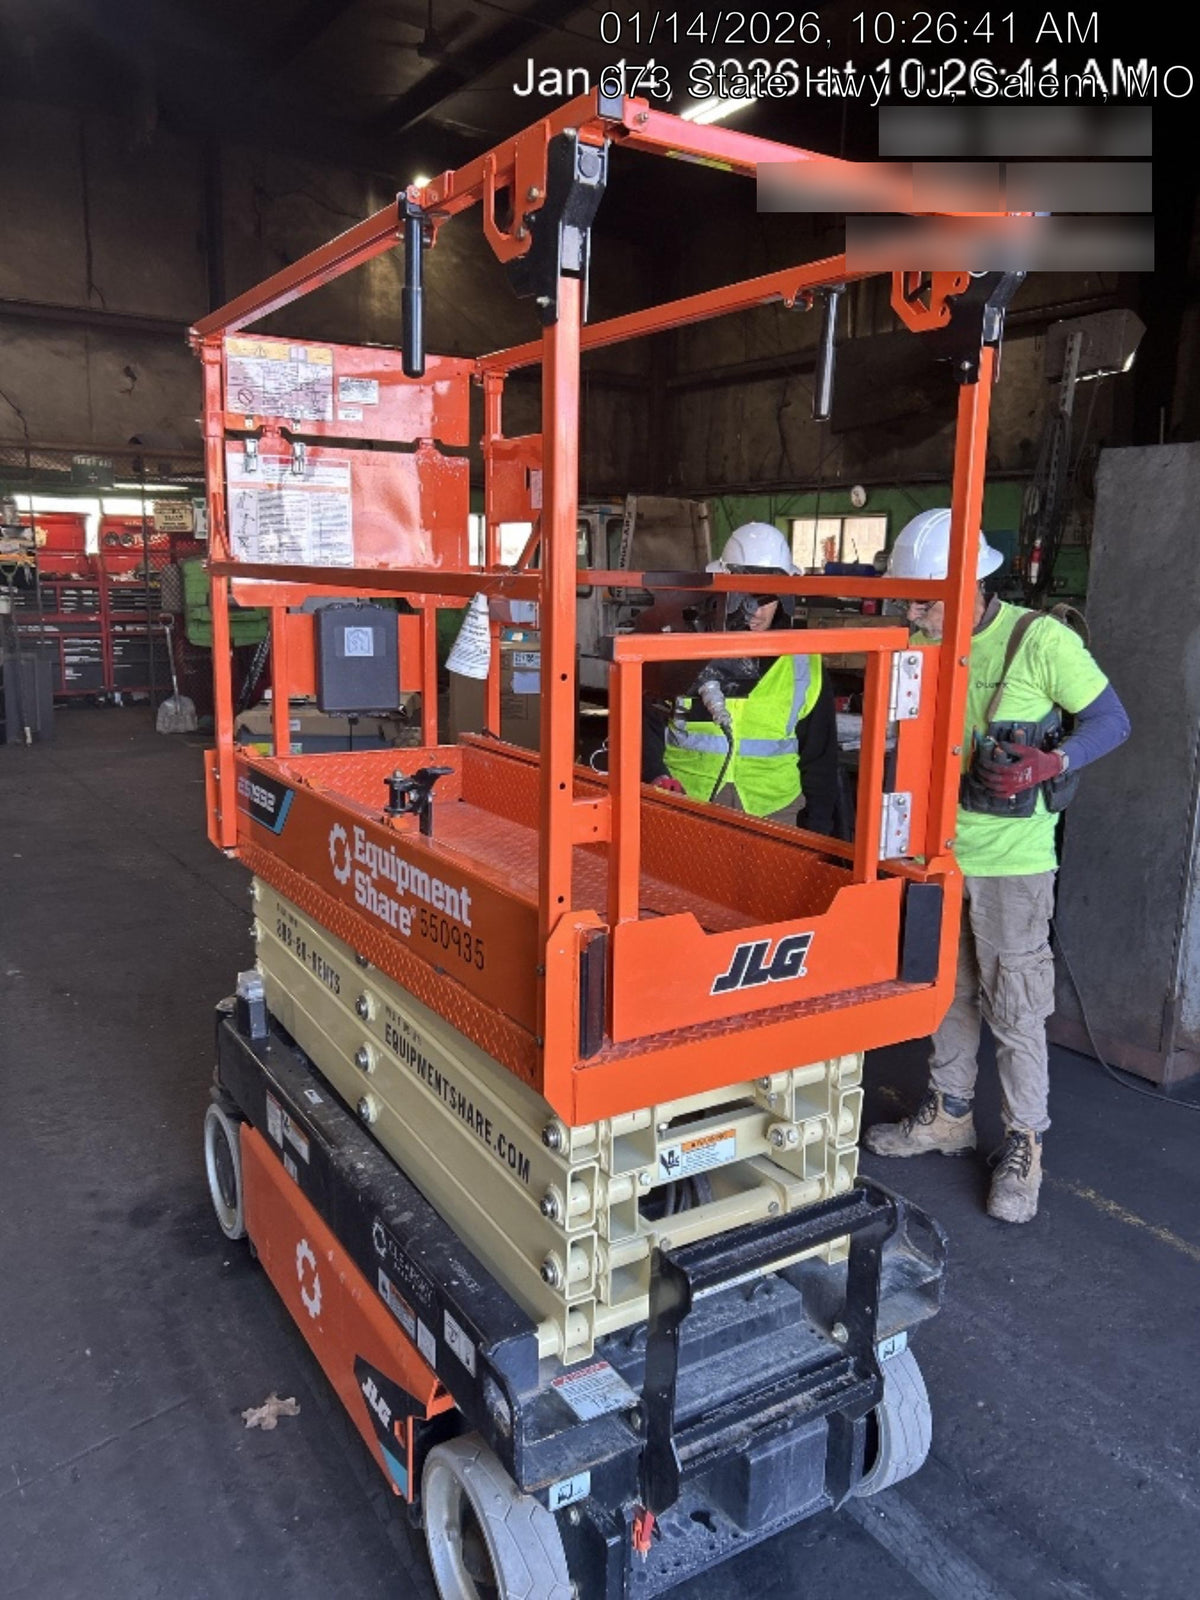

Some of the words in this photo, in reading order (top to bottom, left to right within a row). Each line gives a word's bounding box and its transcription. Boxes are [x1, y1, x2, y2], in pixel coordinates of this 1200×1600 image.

[352, 824, 472, 928] Equipment
[419, 907, 485, 971] 550935
[710, 931, 815, 996] JLG
[384, 1023, 531, 1184] EQUIPMENTSHARE.COM
